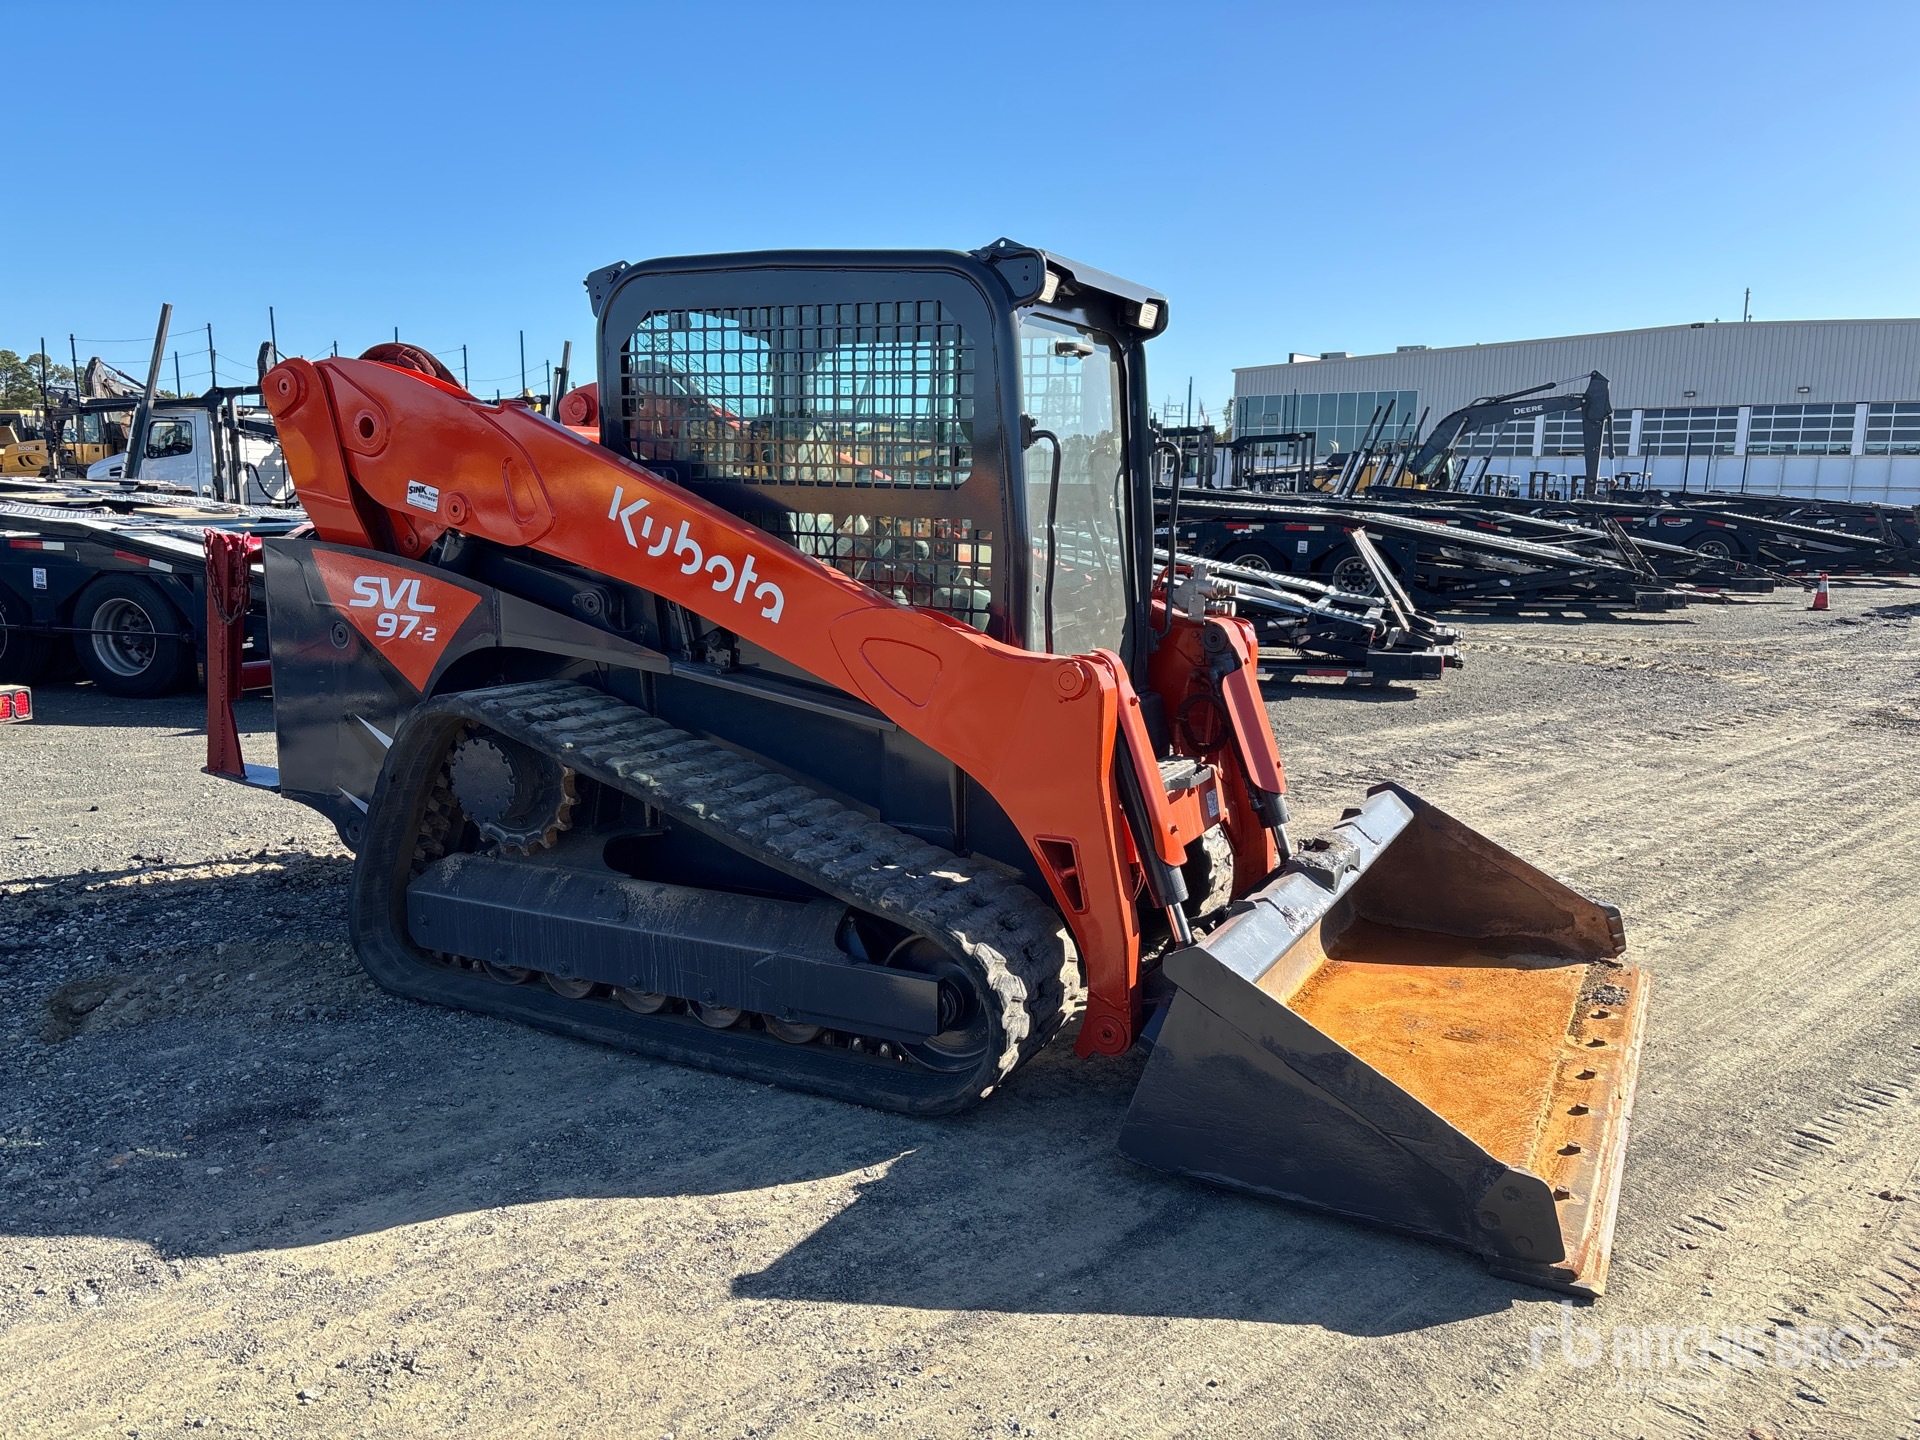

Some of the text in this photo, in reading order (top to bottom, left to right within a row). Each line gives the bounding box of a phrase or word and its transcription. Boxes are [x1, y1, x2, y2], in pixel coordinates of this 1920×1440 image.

[1513, 404, 1544, 415] DEERE
[408, 485, 428, 495] SINK
[608, 485, 785, 624] Kubota
[349, 575, 436, 613] SVL
[375, 612, 437, 642] 97-2
